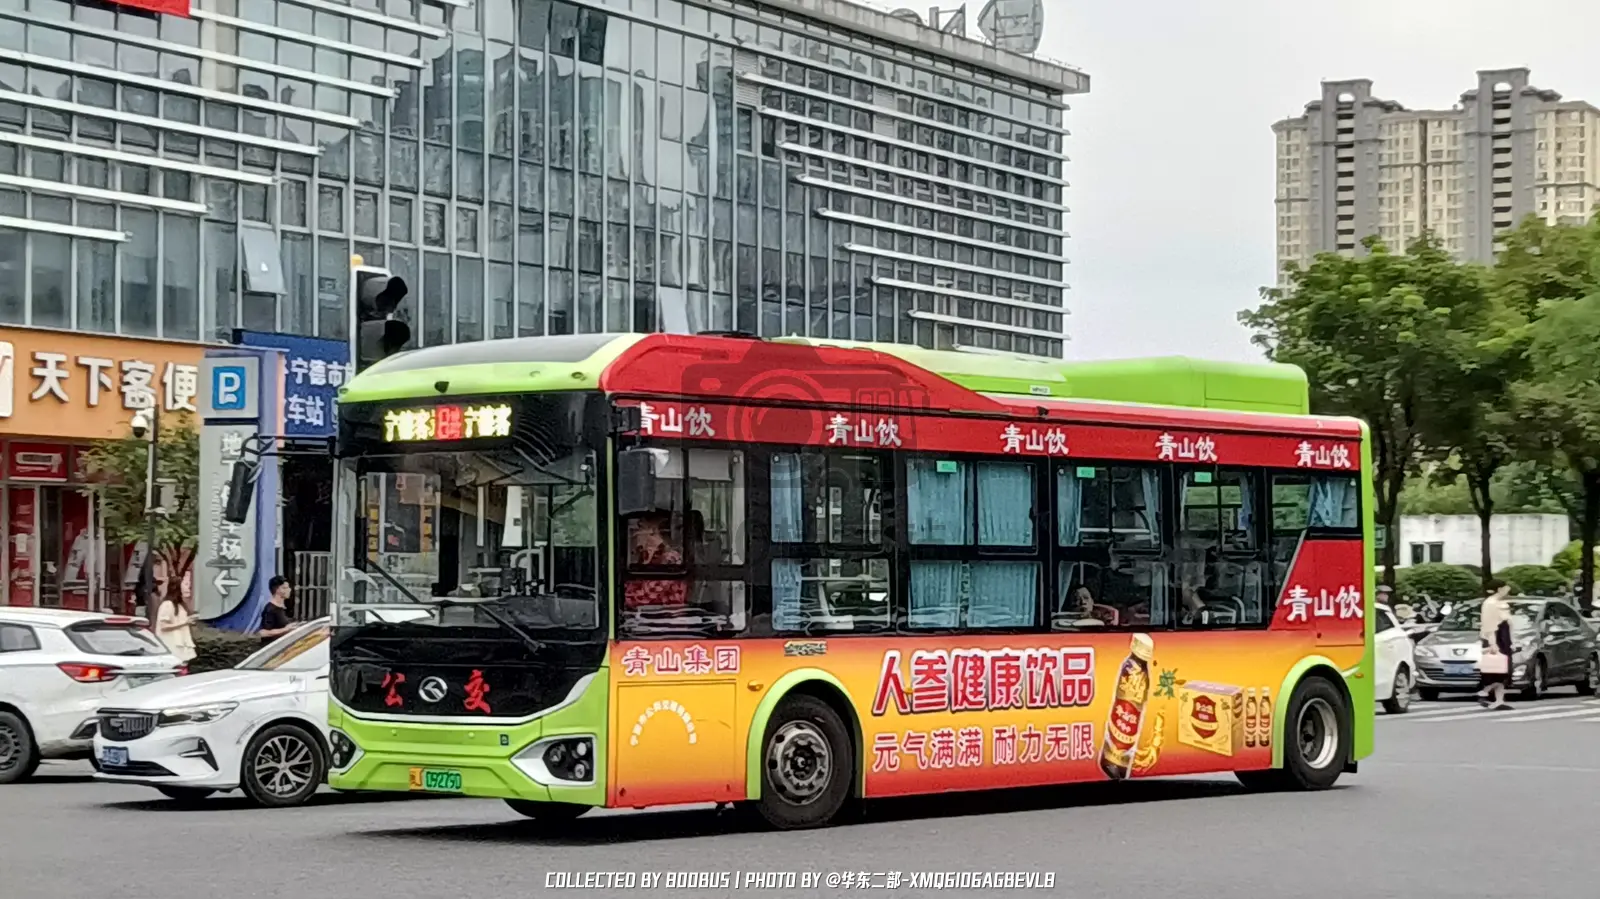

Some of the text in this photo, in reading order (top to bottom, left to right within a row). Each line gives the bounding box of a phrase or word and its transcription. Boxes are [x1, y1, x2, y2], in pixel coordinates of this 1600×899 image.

[31, 351, 199, 412] 天下客便
[284, 356, 351, 388] 宁德市
[218, 373, 243, 405] P
[284, 394, 338, 427] 车站
[825, 413, 902, 447] 青山饮
[1000, 423, 1069, 455] 青山饮
[1155, 432, 1217, 462] 青山饮
[1294, 441, 1351, 468] 青山饮
[1283, 585, 1363, 622] 青山饮
[621, 644, 741, 677] 青山集团
[381, 669, 492, 714] 公 交
[872, 647, 1094, 716] 人参健康饮品
[873, 722, 1094, 772] 元气满满 耐力无限
